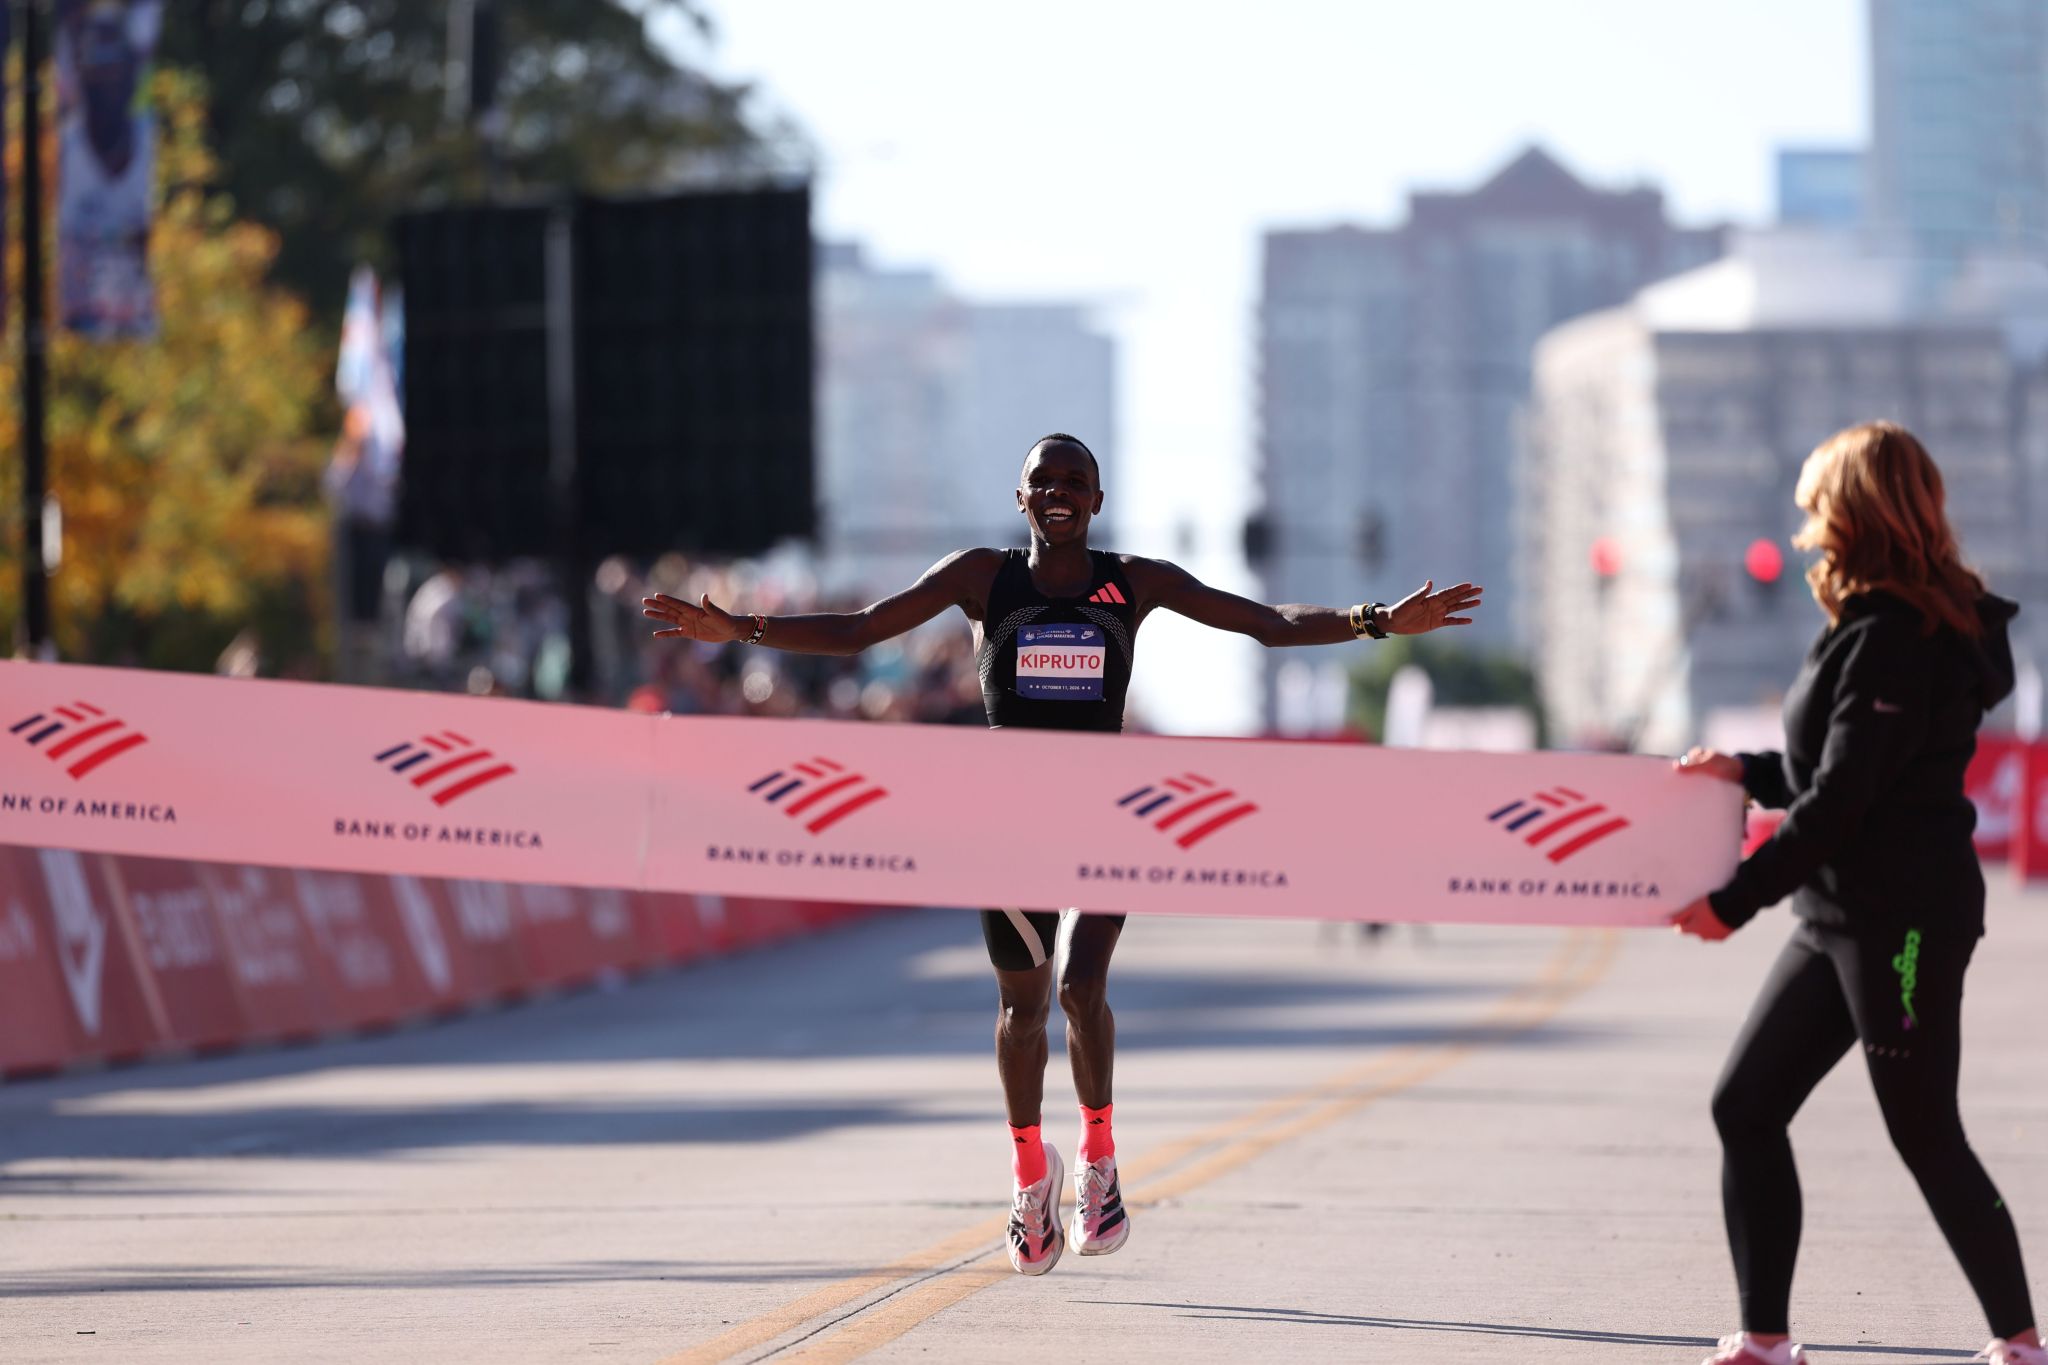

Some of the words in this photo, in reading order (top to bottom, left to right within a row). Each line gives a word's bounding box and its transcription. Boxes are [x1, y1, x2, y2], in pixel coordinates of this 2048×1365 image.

[1021, 654, 1100, 669] KIPRUTO
[2, 793, 33, 812] NK
[40, 796, 68, 815] OF
[74, 799, 177, 823] AMERICA
[333, 818, 395, 838] BANK
[403, 824, 431, 840] OF
[437, 826, 542, 849] AMERICA
[706, 845, 769, 863] BANK
[776, 851, 805, 866] OF
[811, 853, 916, 873] AMERICA
[1077, 864, 1140, 881] BANK
[1147, 868, 1176, 883] OF
[1182, 869, 1288, 888] AMERICA
[1448, 878, 1512, 894] BANK
[1519, 880, 1547, 896] OF
[1554, 881, 1661, 898] AMERICA
